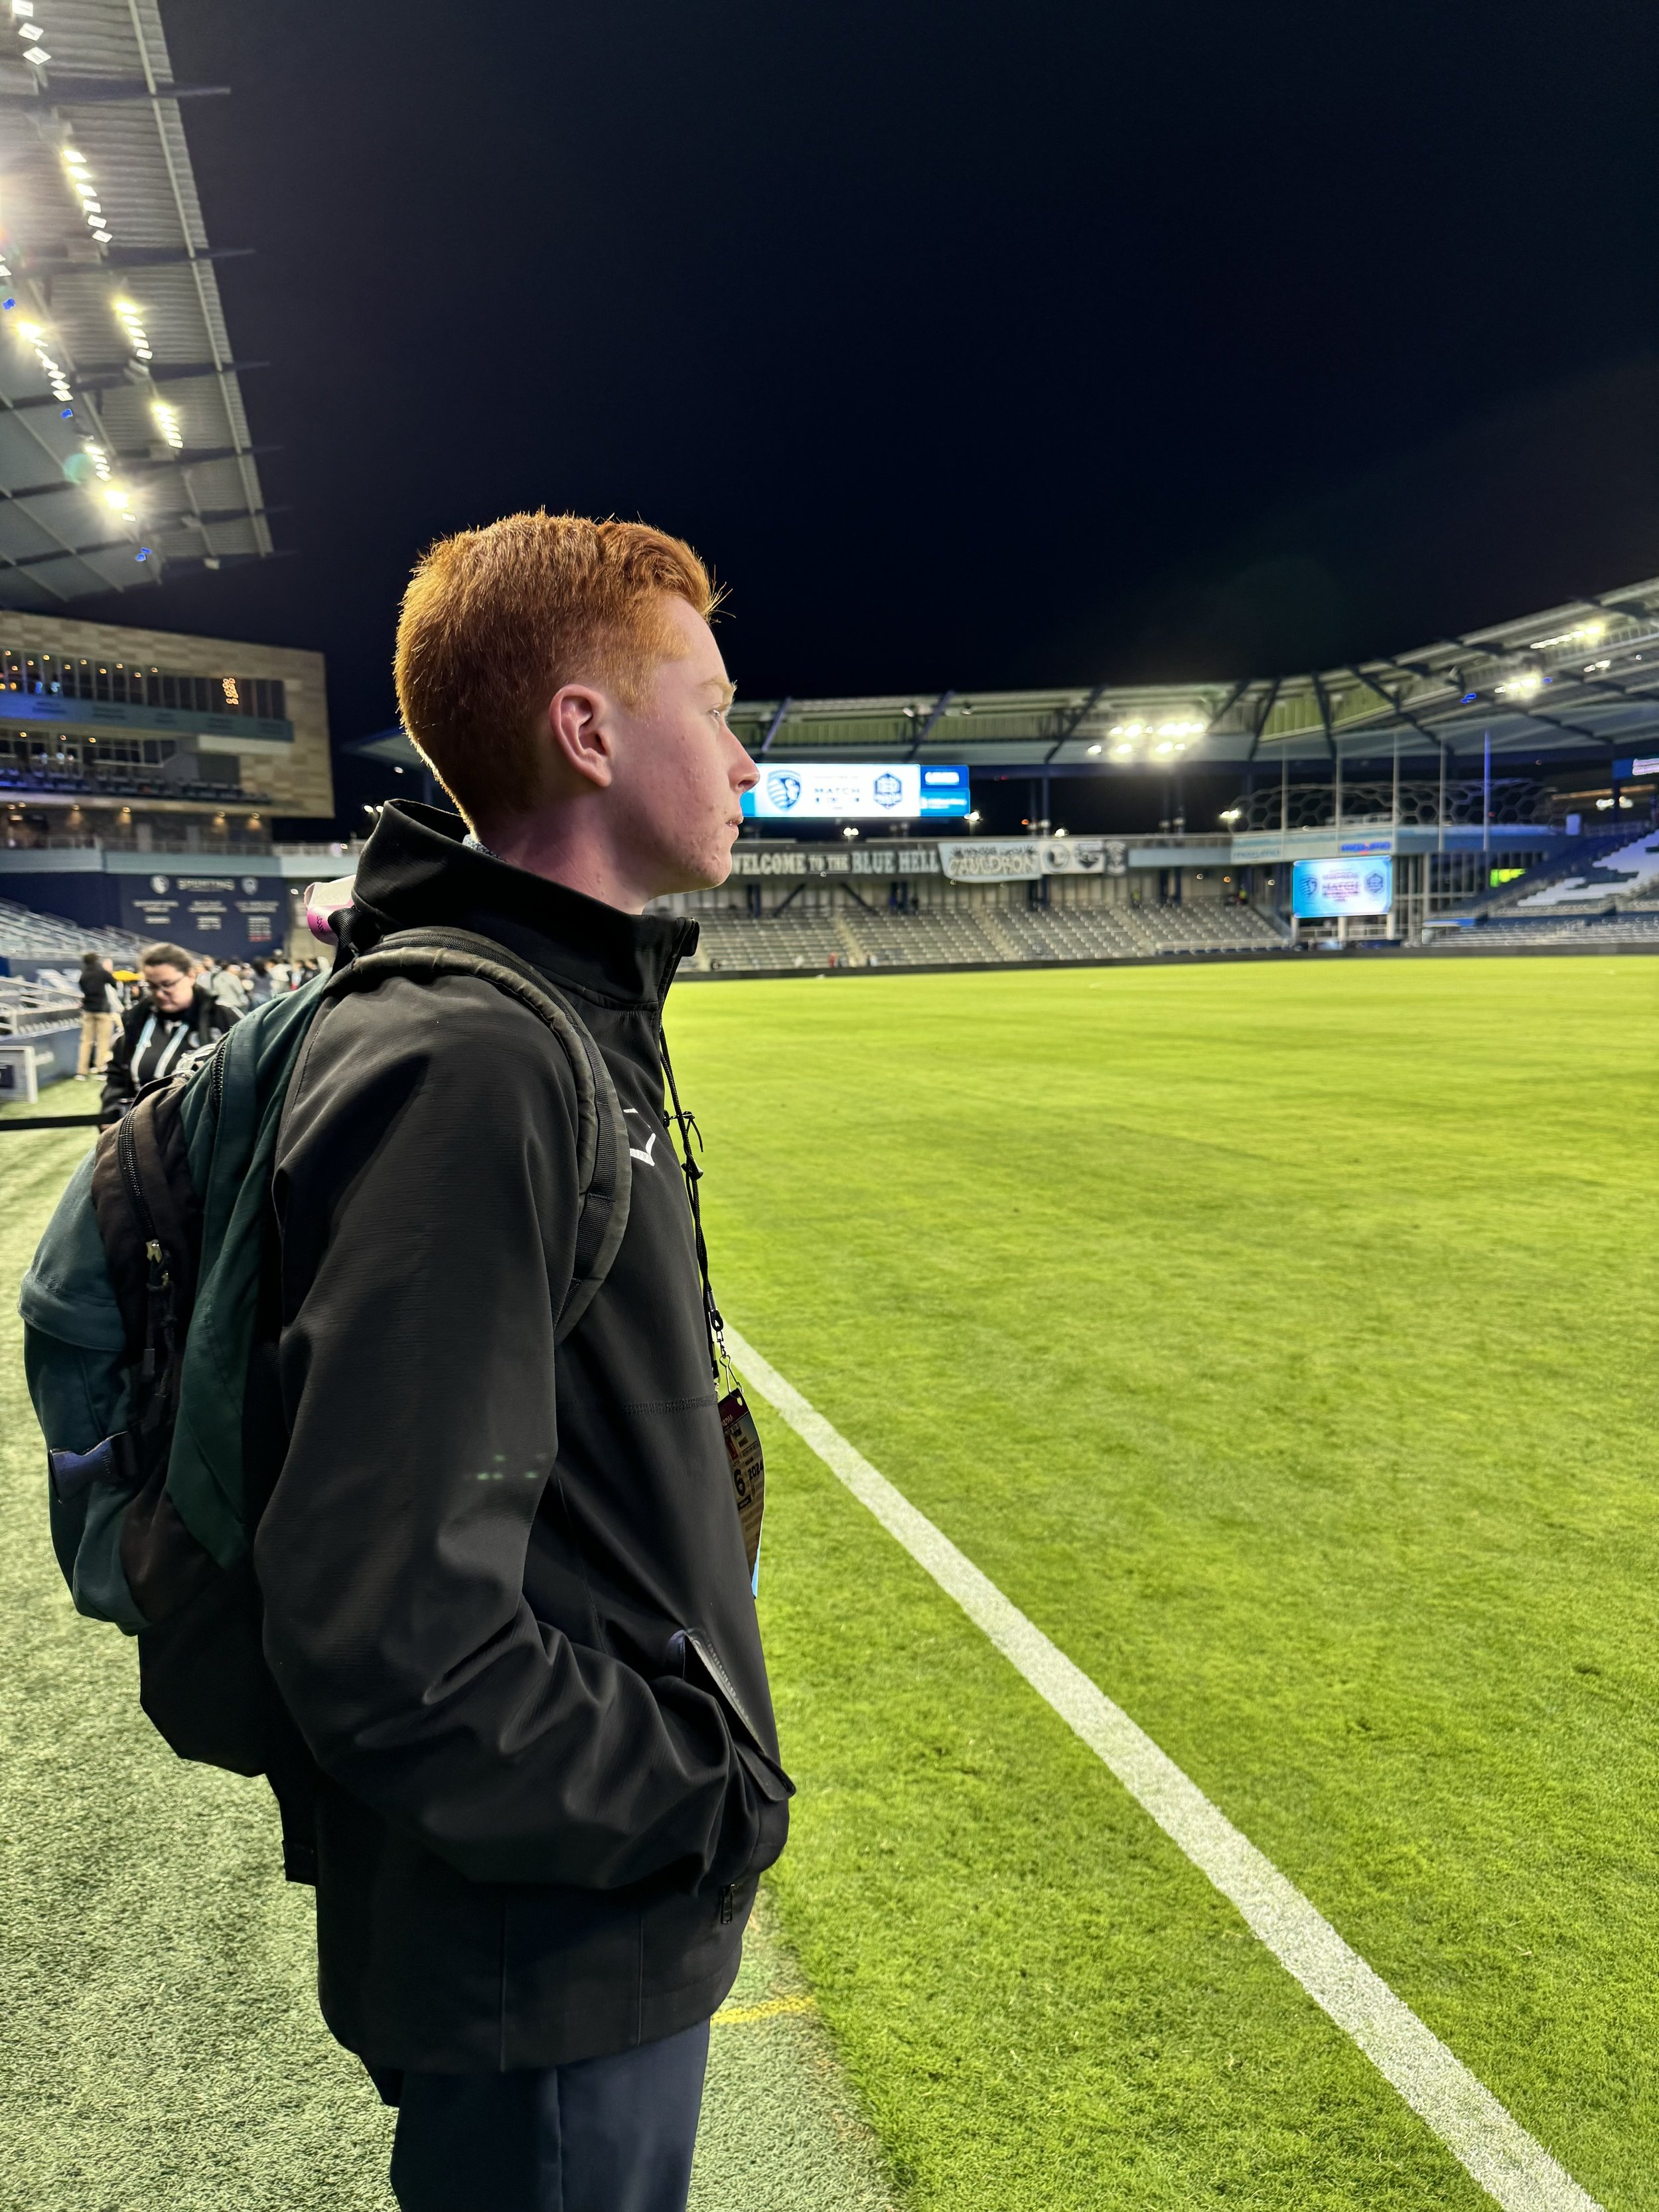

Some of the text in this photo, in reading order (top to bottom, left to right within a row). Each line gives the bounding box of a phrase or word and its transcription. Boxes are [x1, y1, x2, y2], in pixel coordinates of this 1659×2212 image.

[731, 850, 940, 875] WELCOME TO THE BLUE HELL
[948, 853, 1039, 876] CAULDRON
